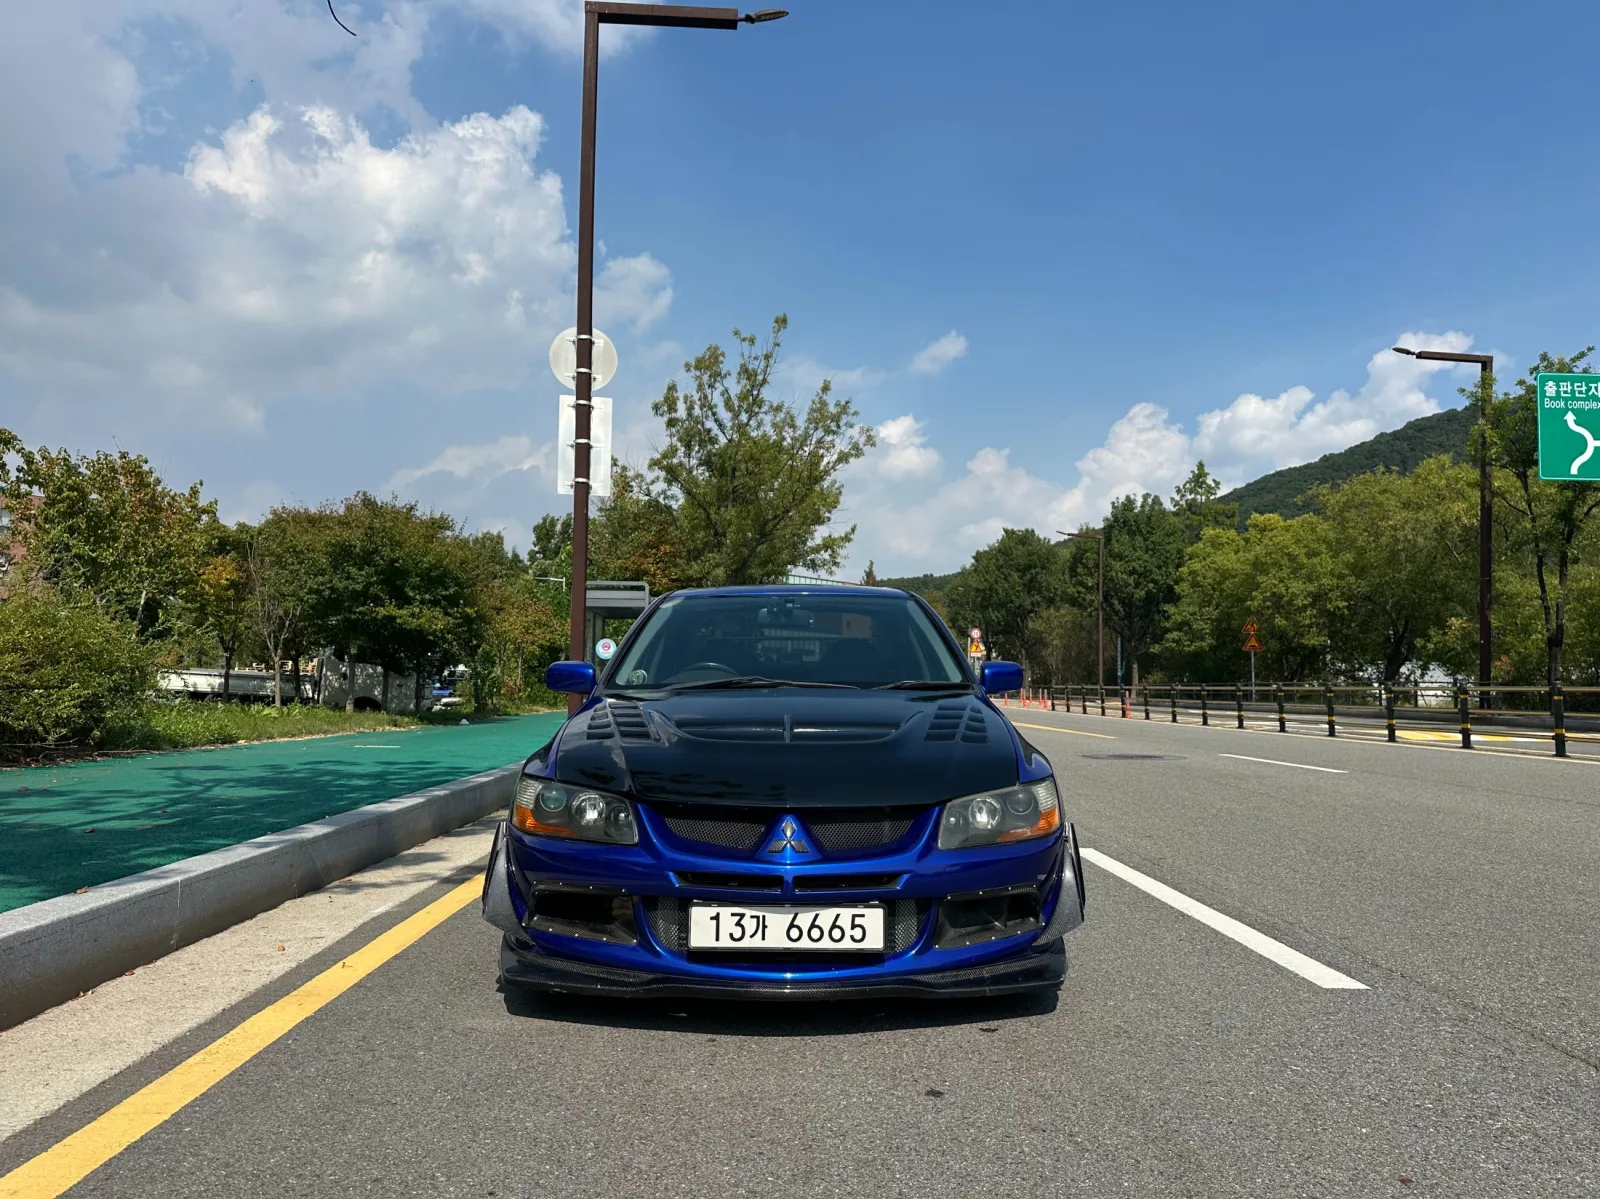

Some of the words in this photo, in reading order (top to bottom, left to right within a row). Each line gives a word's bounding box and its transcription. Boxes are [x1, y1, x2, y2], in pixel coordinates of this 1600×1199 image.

[1544, 380, 1600, 397] 출판단지
[1544, 398, 1565, 409] Book
[709, 911, 768, 942] 13가
[785, 912, 867, 943] 6665
